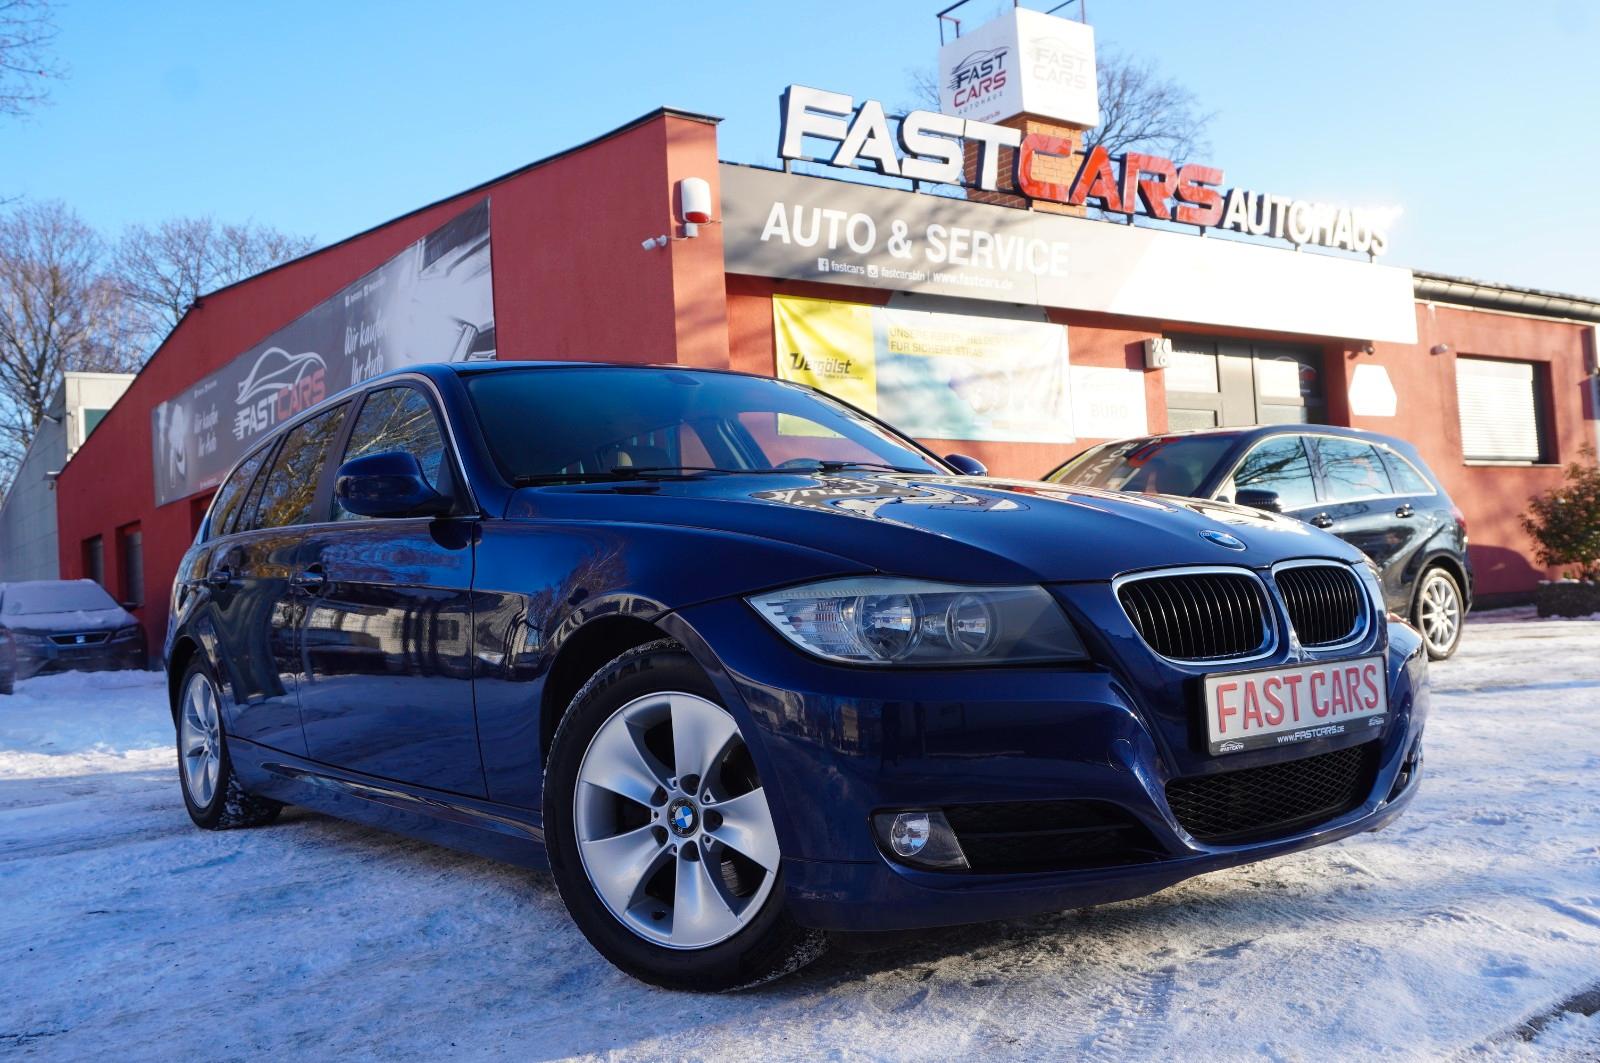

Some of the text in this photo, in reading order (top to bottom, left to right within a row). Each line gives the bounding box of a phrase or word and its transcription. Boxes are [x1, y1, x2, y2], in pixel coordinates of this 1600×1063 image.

[954, 70, 1006, 107] CARS
[956, 51, 1008, 88] FAST
[761, 201, 1071, 278] AUTO & SERVICE
[1222, 187, 1389, 256] AUTOHAUS
[831, 260, 865, 275] fastcars
[1216, 664, 1379, 733] FAST CARS
